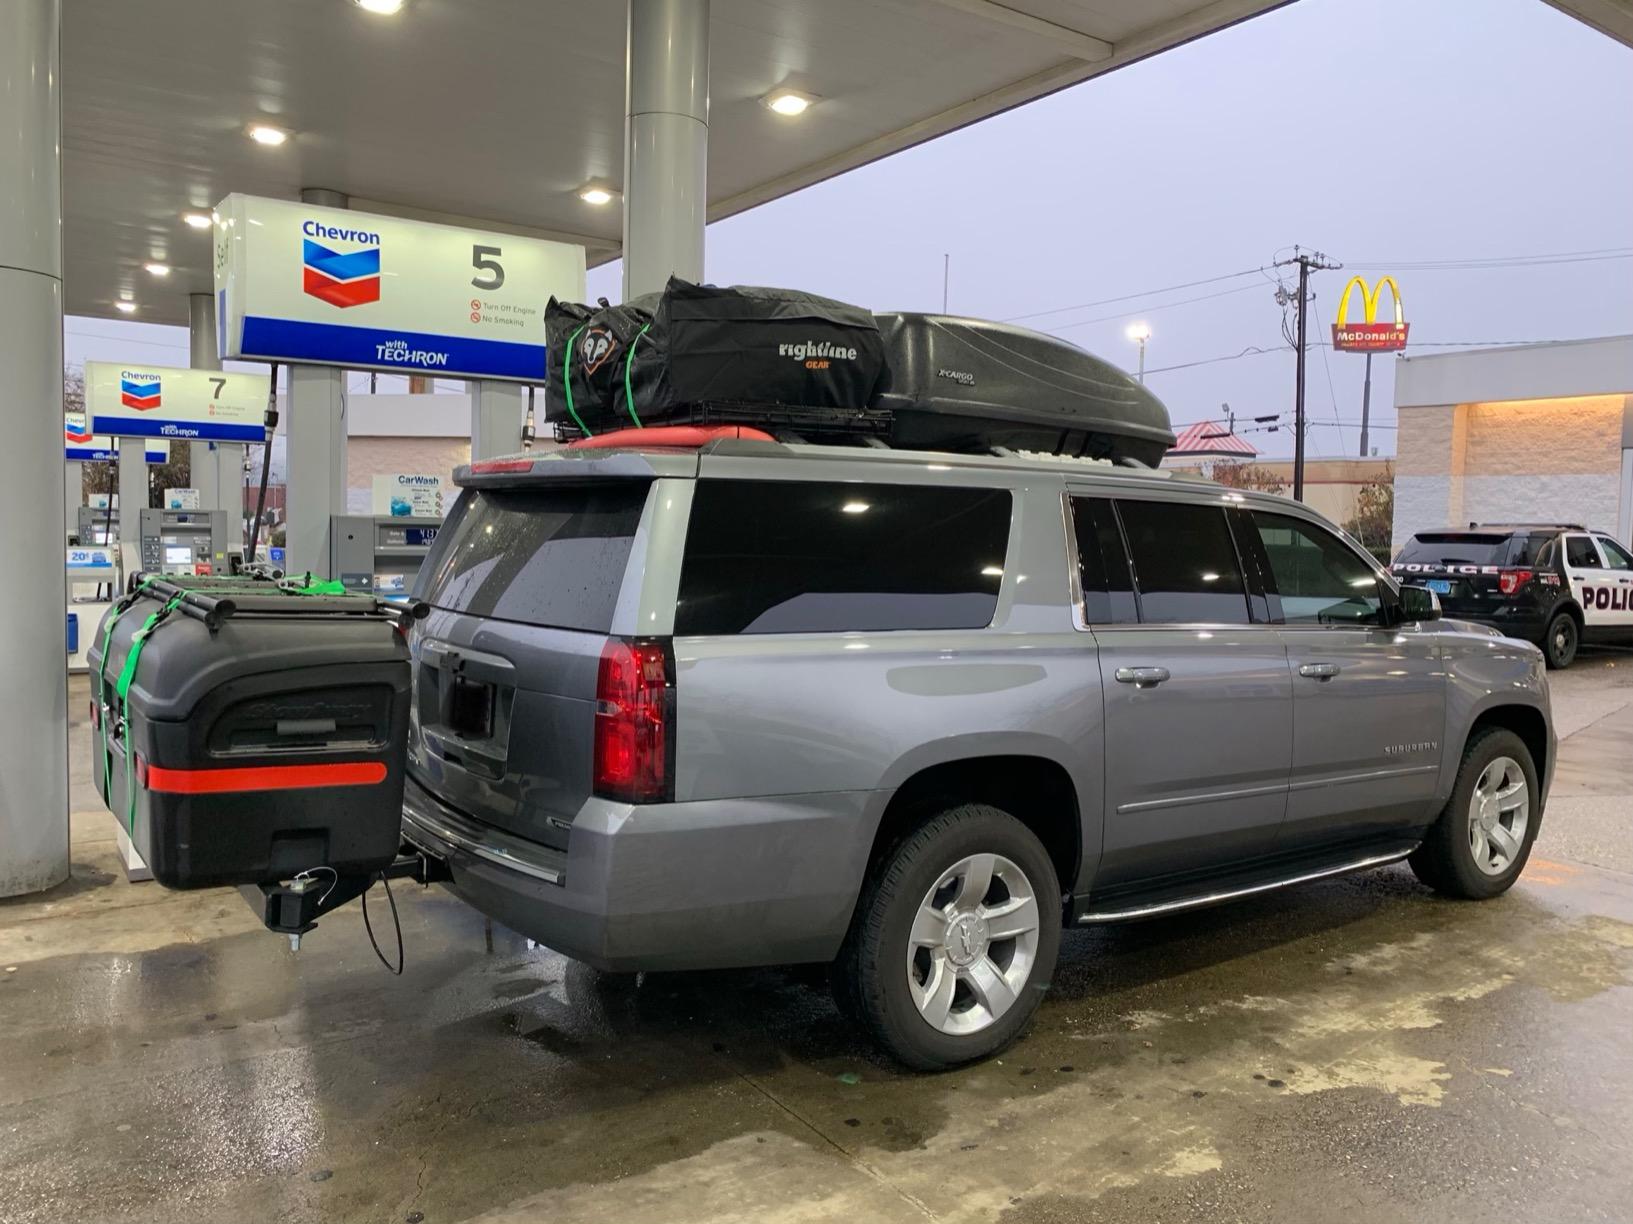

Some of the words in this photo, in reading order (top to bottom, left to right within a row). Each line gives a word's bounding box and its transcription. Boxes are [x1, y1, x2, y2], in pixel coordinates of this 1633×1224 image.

[303, 221, 380, 245] Chevron
[472, 245, 505, 290] 5
[483, 302, 499, 310] Turn
[513, 306, 536, 315] Engine
[482, 315, 493, 323] No
[494, 316, 525, 327] Smoking
[1337, 331, 1406, 341] McDonald's
[385, 340, 408, 350] with
[779, 340, 857, 361] rightline
[376, 344, 448, 367] TECHRON
[121, 370, 161, 381] Chevron
[208, 377, 227, 400] 7
[160, 426, 199, 437] TECHRON
[398, 475, 439, 485] CarWash
